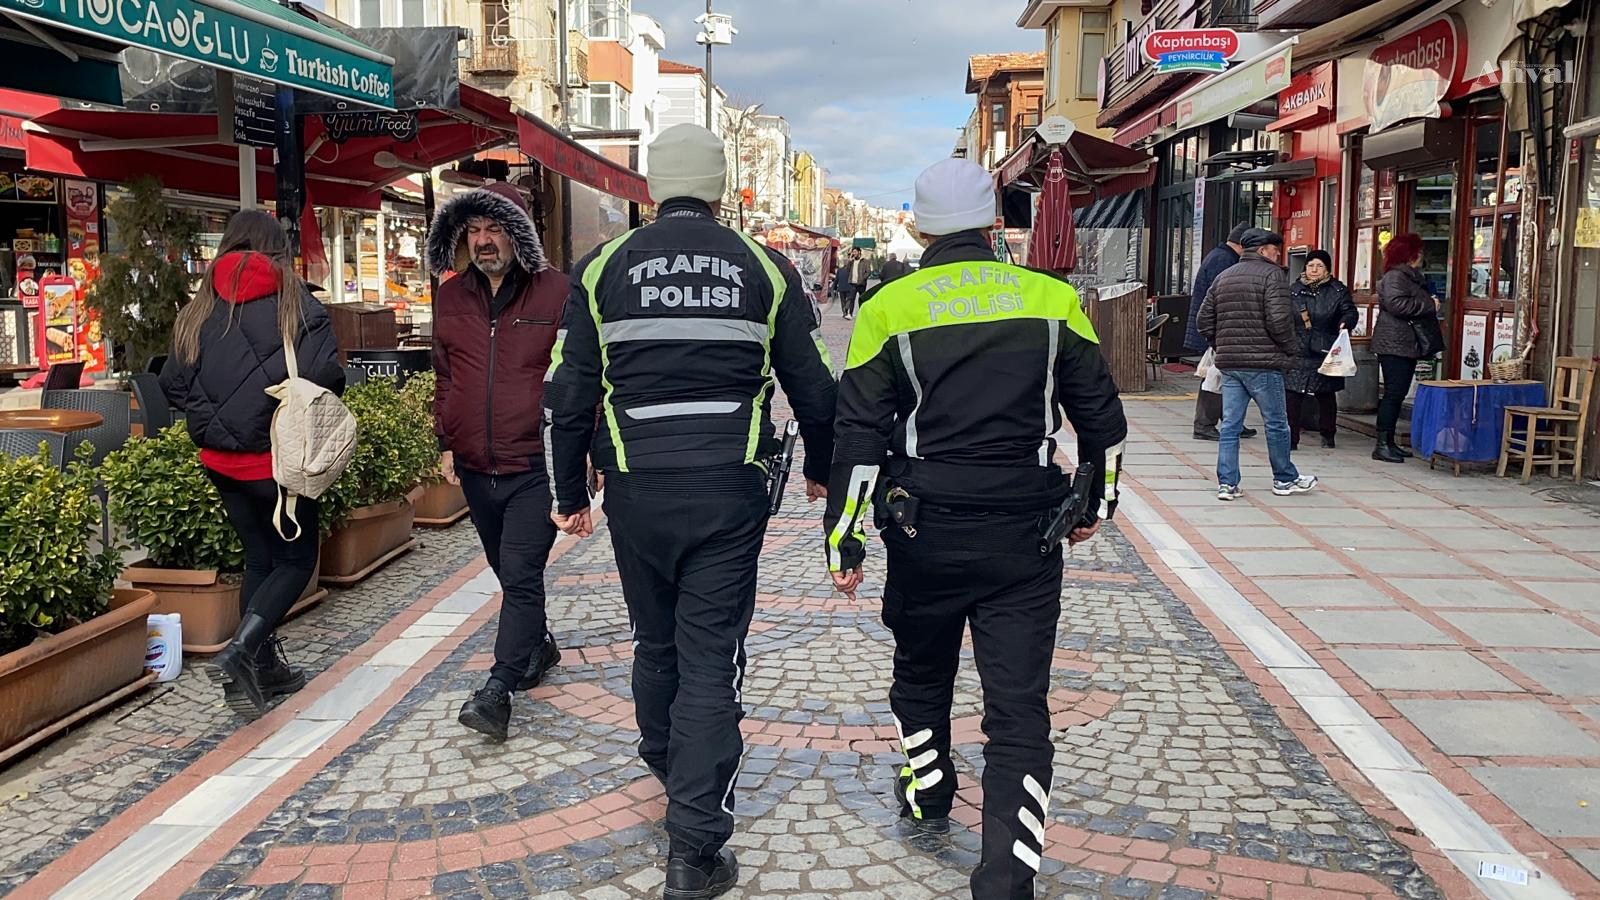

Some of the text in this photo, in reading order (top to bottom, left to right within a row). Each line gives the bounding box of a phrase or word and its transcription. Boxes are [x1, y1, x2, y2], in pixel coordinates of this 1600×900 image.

[1153, 34, 1231, 50] Kaptanbaşı
[1168, 52, 1215, 62] PEYNİRCİLİK
[285, 47, 390, 99] Turkish Coffee
[1282, 82, 1326, 112] AKBANK
